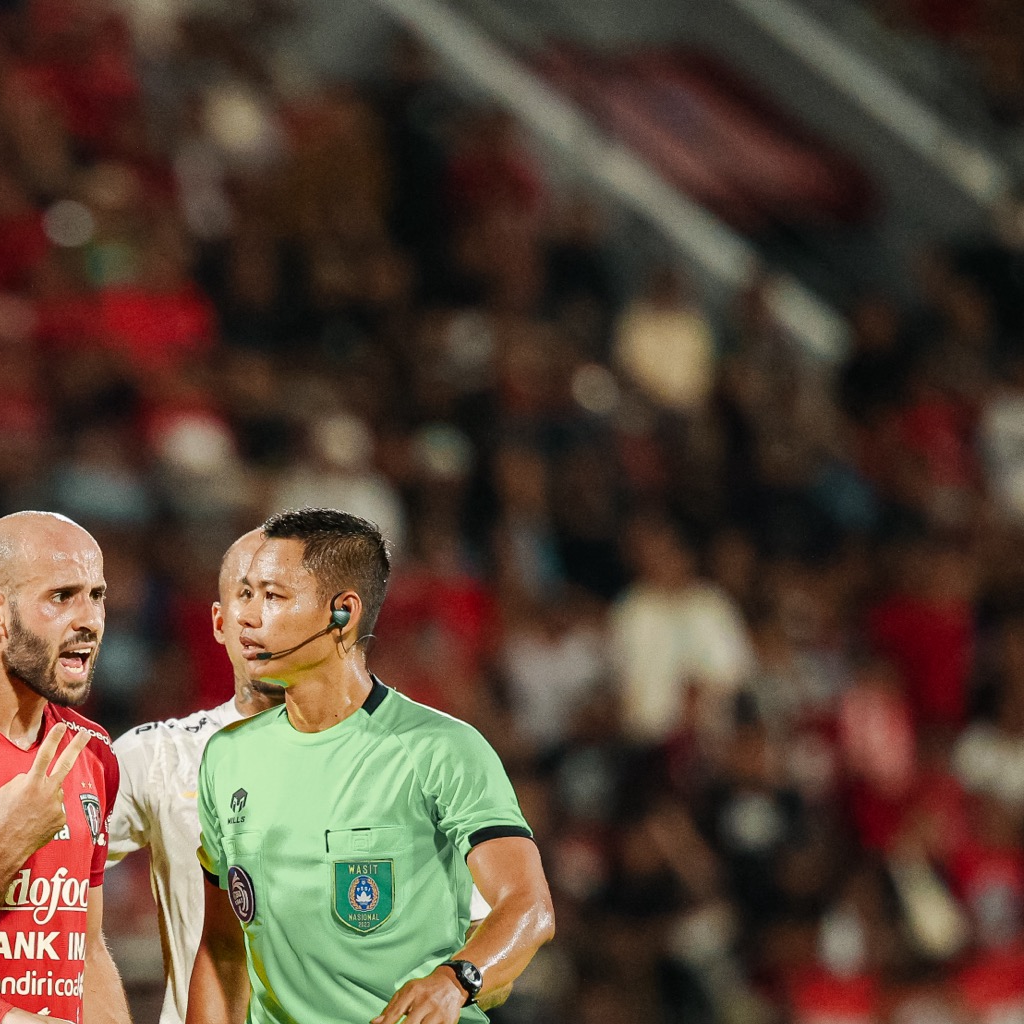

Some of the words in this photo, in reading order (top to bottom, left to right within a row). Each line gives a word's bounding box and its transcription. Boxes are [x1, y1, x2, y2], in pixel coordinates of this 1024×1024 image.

[227, 815, 246, 825] MILLS
[348, 864, 378, 874] WASIT
[348, 913, 380, 921] NASIONAL
